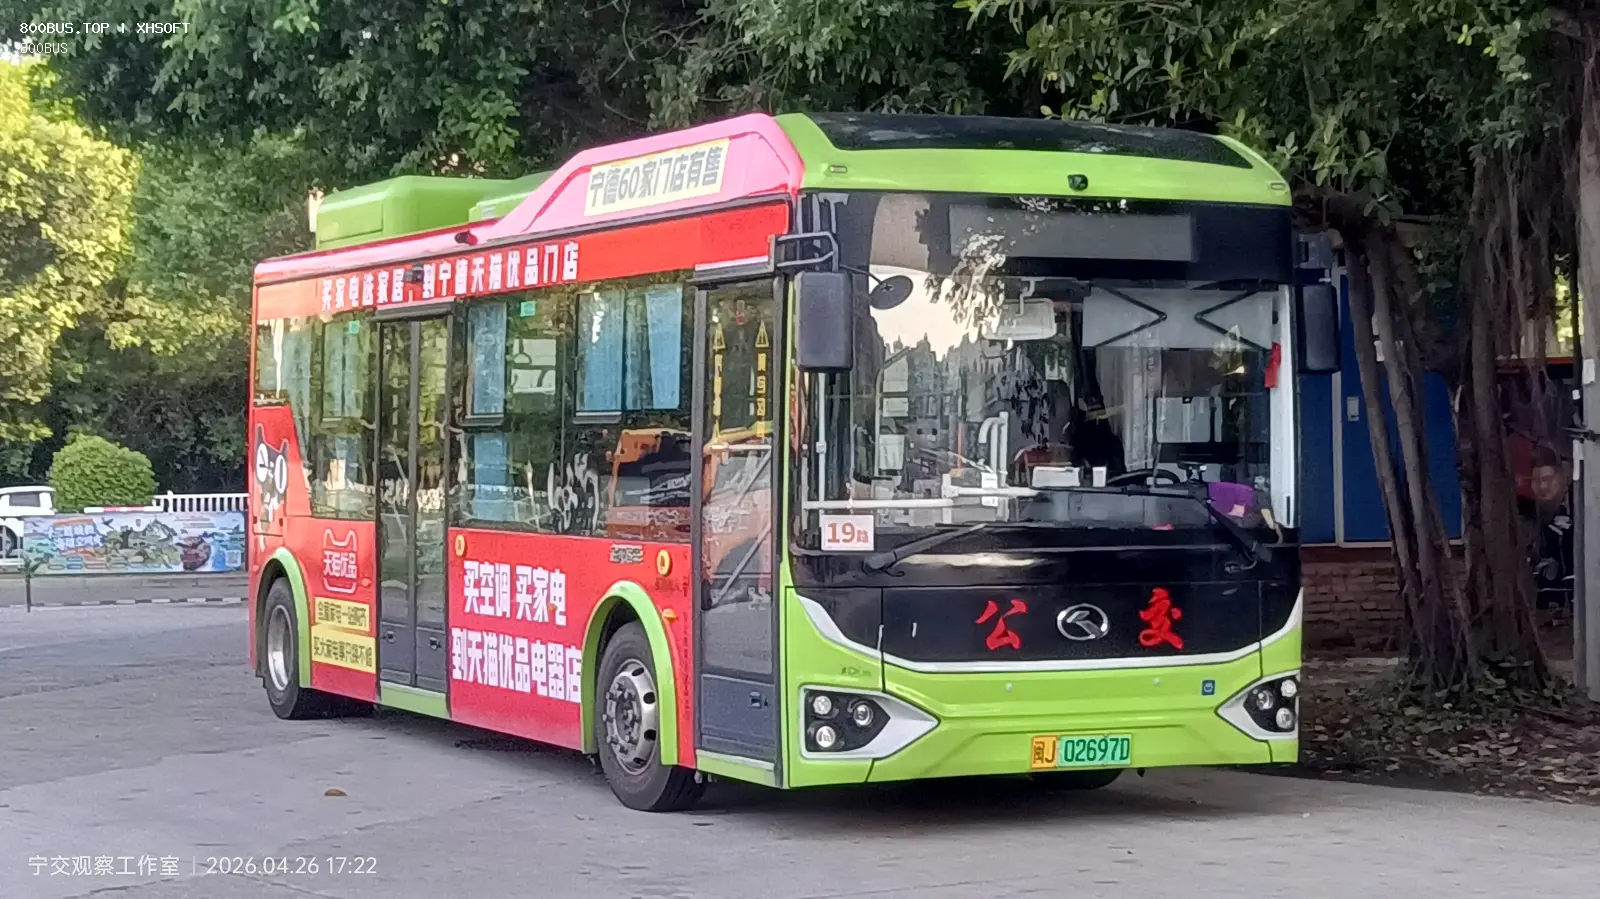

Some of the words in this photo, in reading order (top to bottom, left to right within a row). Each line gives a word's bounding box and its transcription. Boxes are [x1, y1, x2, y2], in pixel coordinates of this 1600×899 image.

[463, 560, 511, 618] 买空调
[515, 564, 567, 626] 买家电
[975, 600, 1028, 651] 公
[451, 627, 582, 703] 到天猫优品电器店
